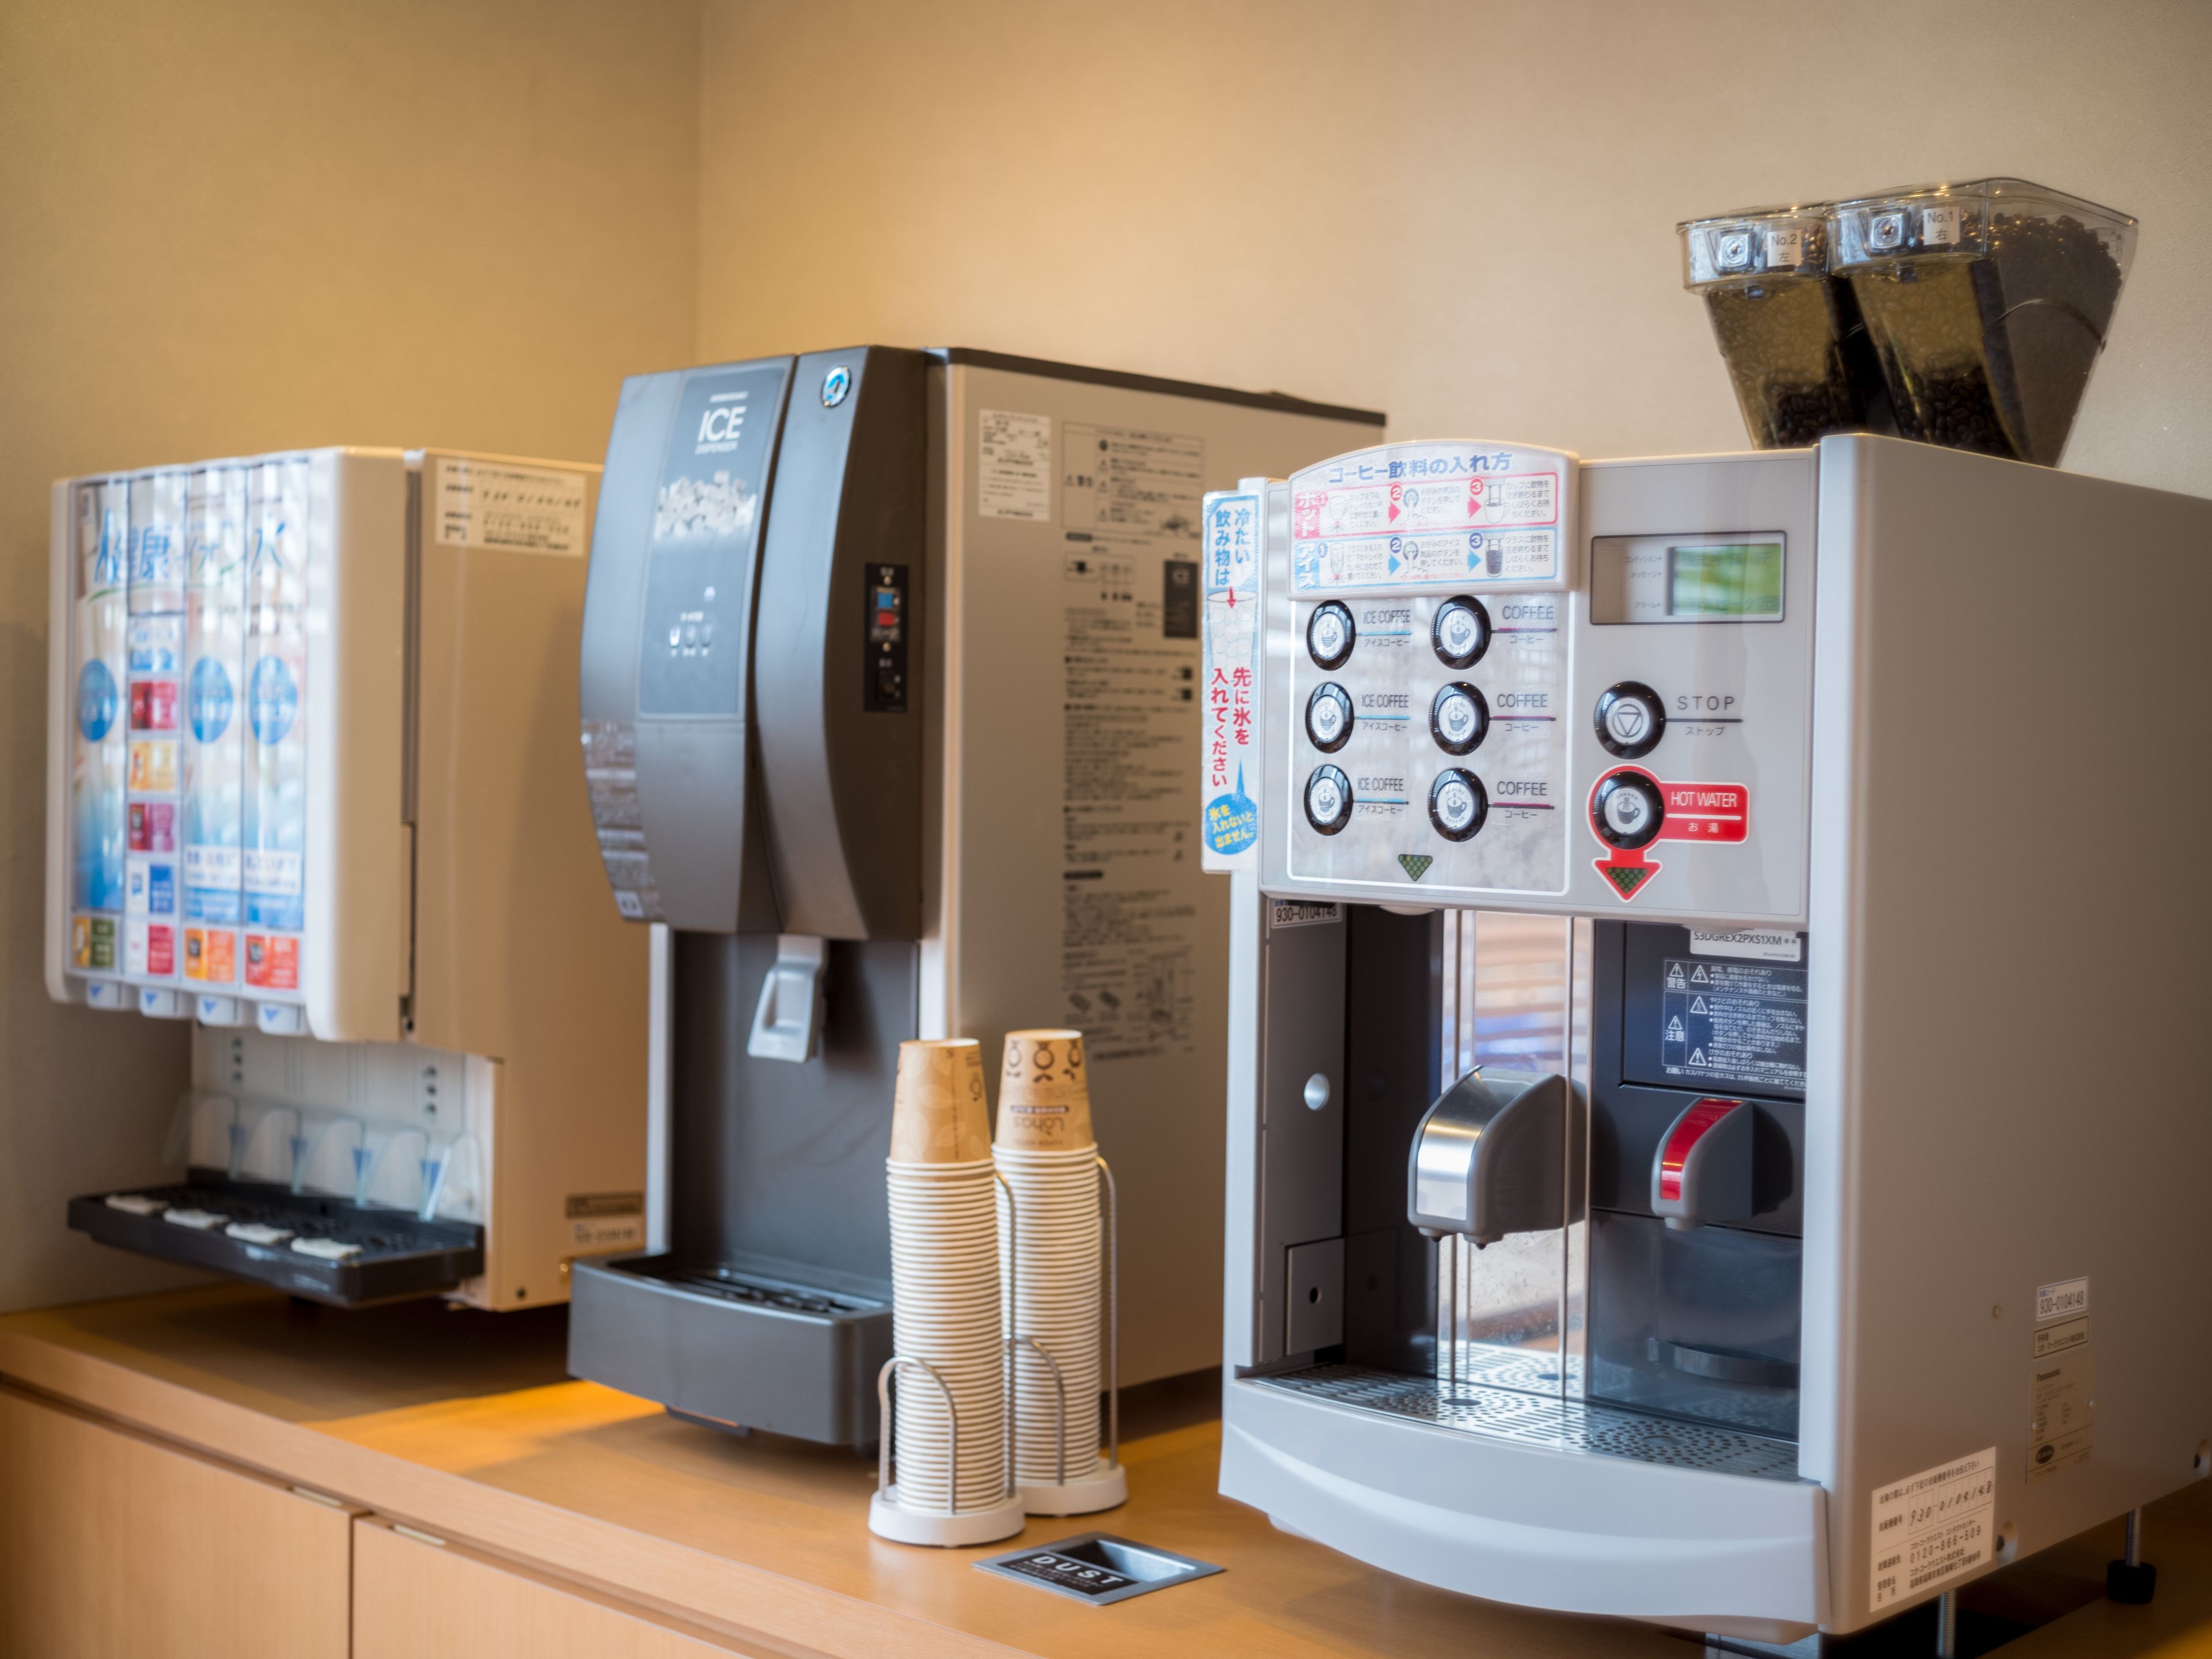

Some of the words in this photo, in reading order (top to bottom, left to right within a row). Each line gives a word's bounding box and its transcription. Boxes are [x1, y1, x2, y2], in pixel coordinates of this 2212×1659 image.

[1927, 212, 1955, 224] No.1
[1771, 234, 1797, 246] No.2
[1936, 228, 1948, 241] 右
[1779, 251, 1789, 263] 左
[698, 406, 747, 442] ICE
[1329, 452, 1513, 483] コーヒー飲料の入れ方
[1298, 493, 1316, 536] ホット
[1235, 508, 1250, 565] 冷たい
[1215, 510, 1230, 586] 飲み物は
[1298, 543, 1316, 588] アイス
[1363, 612, 1376, 624] ICE
[1378, 609, 1411, 624] COFFEE
[1502, 606, 1554, 620] COFFEE
[1364, 639, 1410, 647] アイスコーヒー
[1509, 635, 1544, 644] コーヒー
[1233, 667, 1251, 745] 先に氷を
[1361, 694, 1376, 708] ICE
[1377, 694, 1409, 709] COFFEE
[1498, 694, 1548, 708] COFFEE
[1677, 695, 1735, 711] STOP
[1211, 668, 1230, 787] 入れてください
[1362, 722, 1407, 732] アイスコーヒー
[1505, 723, 1539, 732] コーヒー
[1685, 726, 1725, 736] ストップ
[1357, 777, 1371, 791] ICE
[1372, 778, 1404, 791] COFFEE
[1497, 781, 1547, 796] COFFEE
[1671, 791, 1695, 806] HOT
[1696, 792, 1737, 808] WATER
[1209, 805, 1229, 821] 氷を
[1358, 805, 1403, 814] アイスコーヒー
[1505, 810, 1538, 819] コーヒー
[1212, 811, 1254, 834] 入れないと
[1666, 978, 1687, 990] 警告
[1710, 997, 1760, 1007] やけどのおそれあり
[1665, 1030, 1685, 1042] 注意
[1708, 1048, 1753, 1059] けがのおそれあり
[2039, 1290, 2085, 1315] 930-0104148
[1910, 1524, 1982, 1565] 0120-866-509
[1031, 1555, 1124, 1584] DUST
